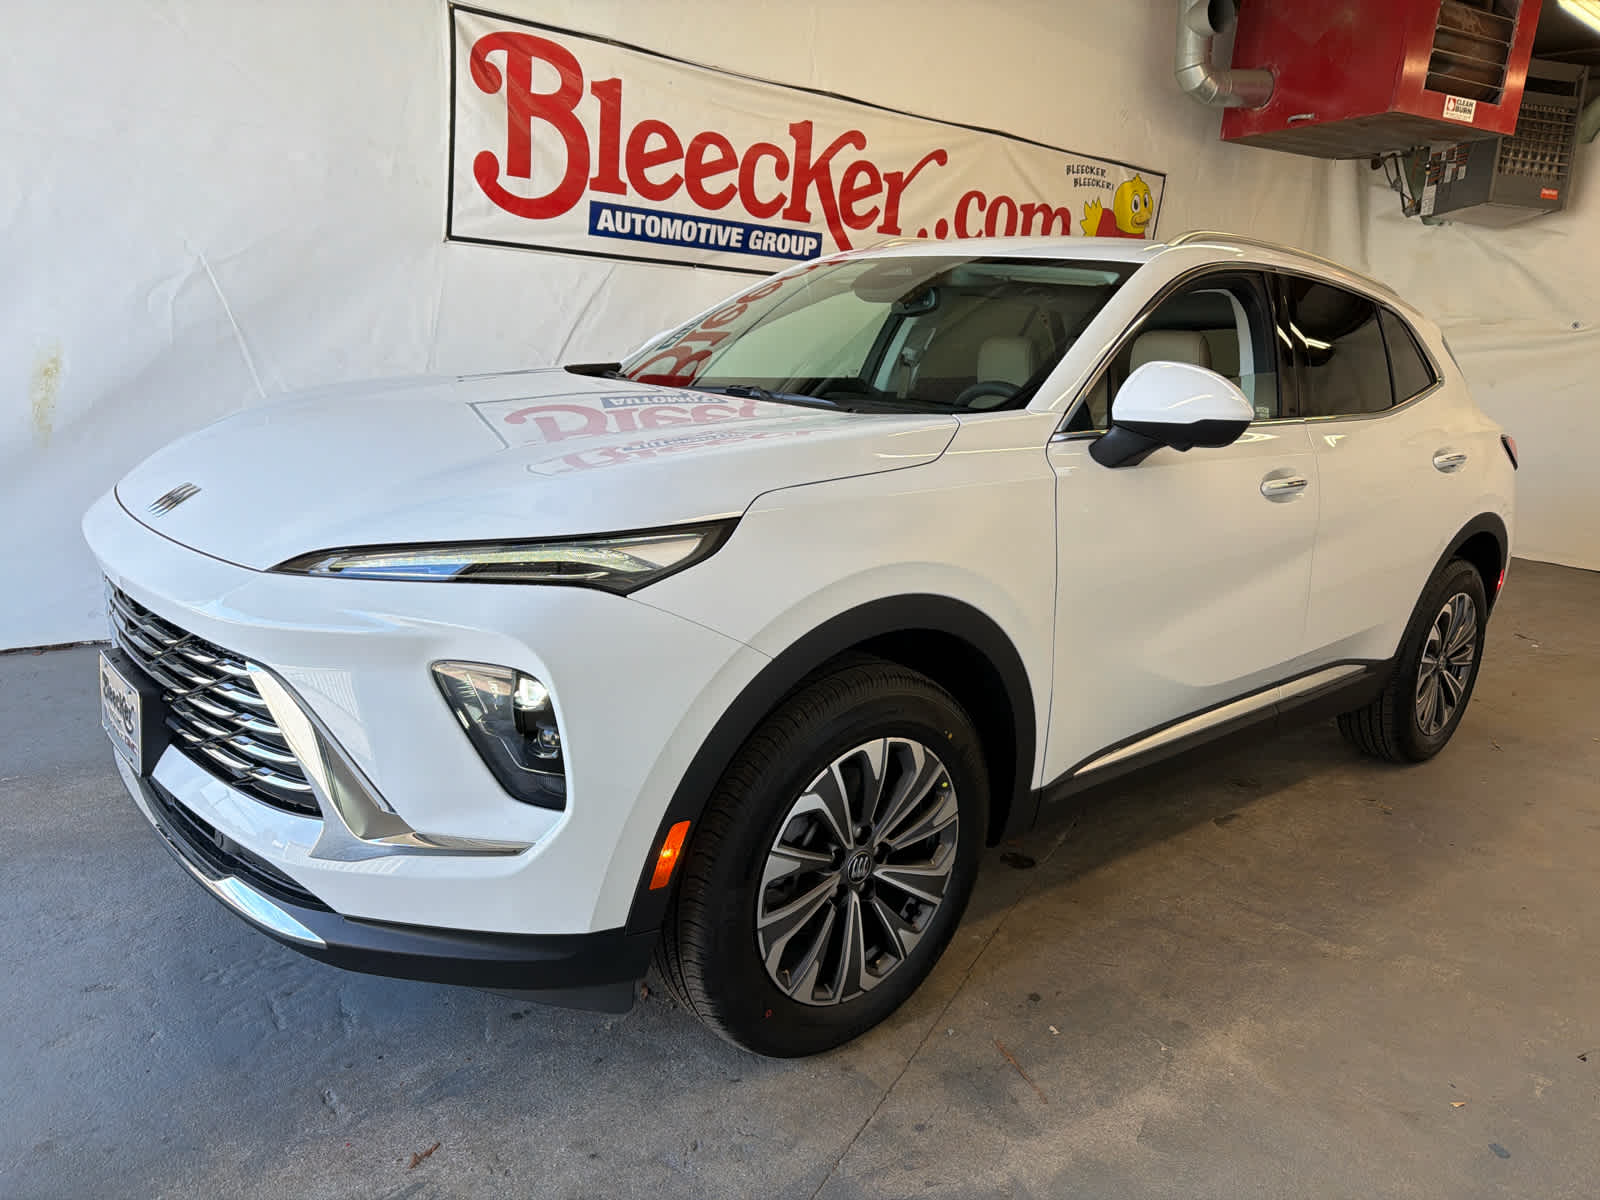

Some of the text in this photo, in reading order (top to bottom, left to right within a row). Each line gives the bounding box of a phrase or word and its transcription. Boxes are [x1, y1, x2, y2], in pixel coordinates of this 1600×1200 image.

[1456, 98, 1475, 108] CLEAN
[1455, 105, 1473, 115] BURN
[597, 208, 818, 256] AUTOMOTIVE GROUP
